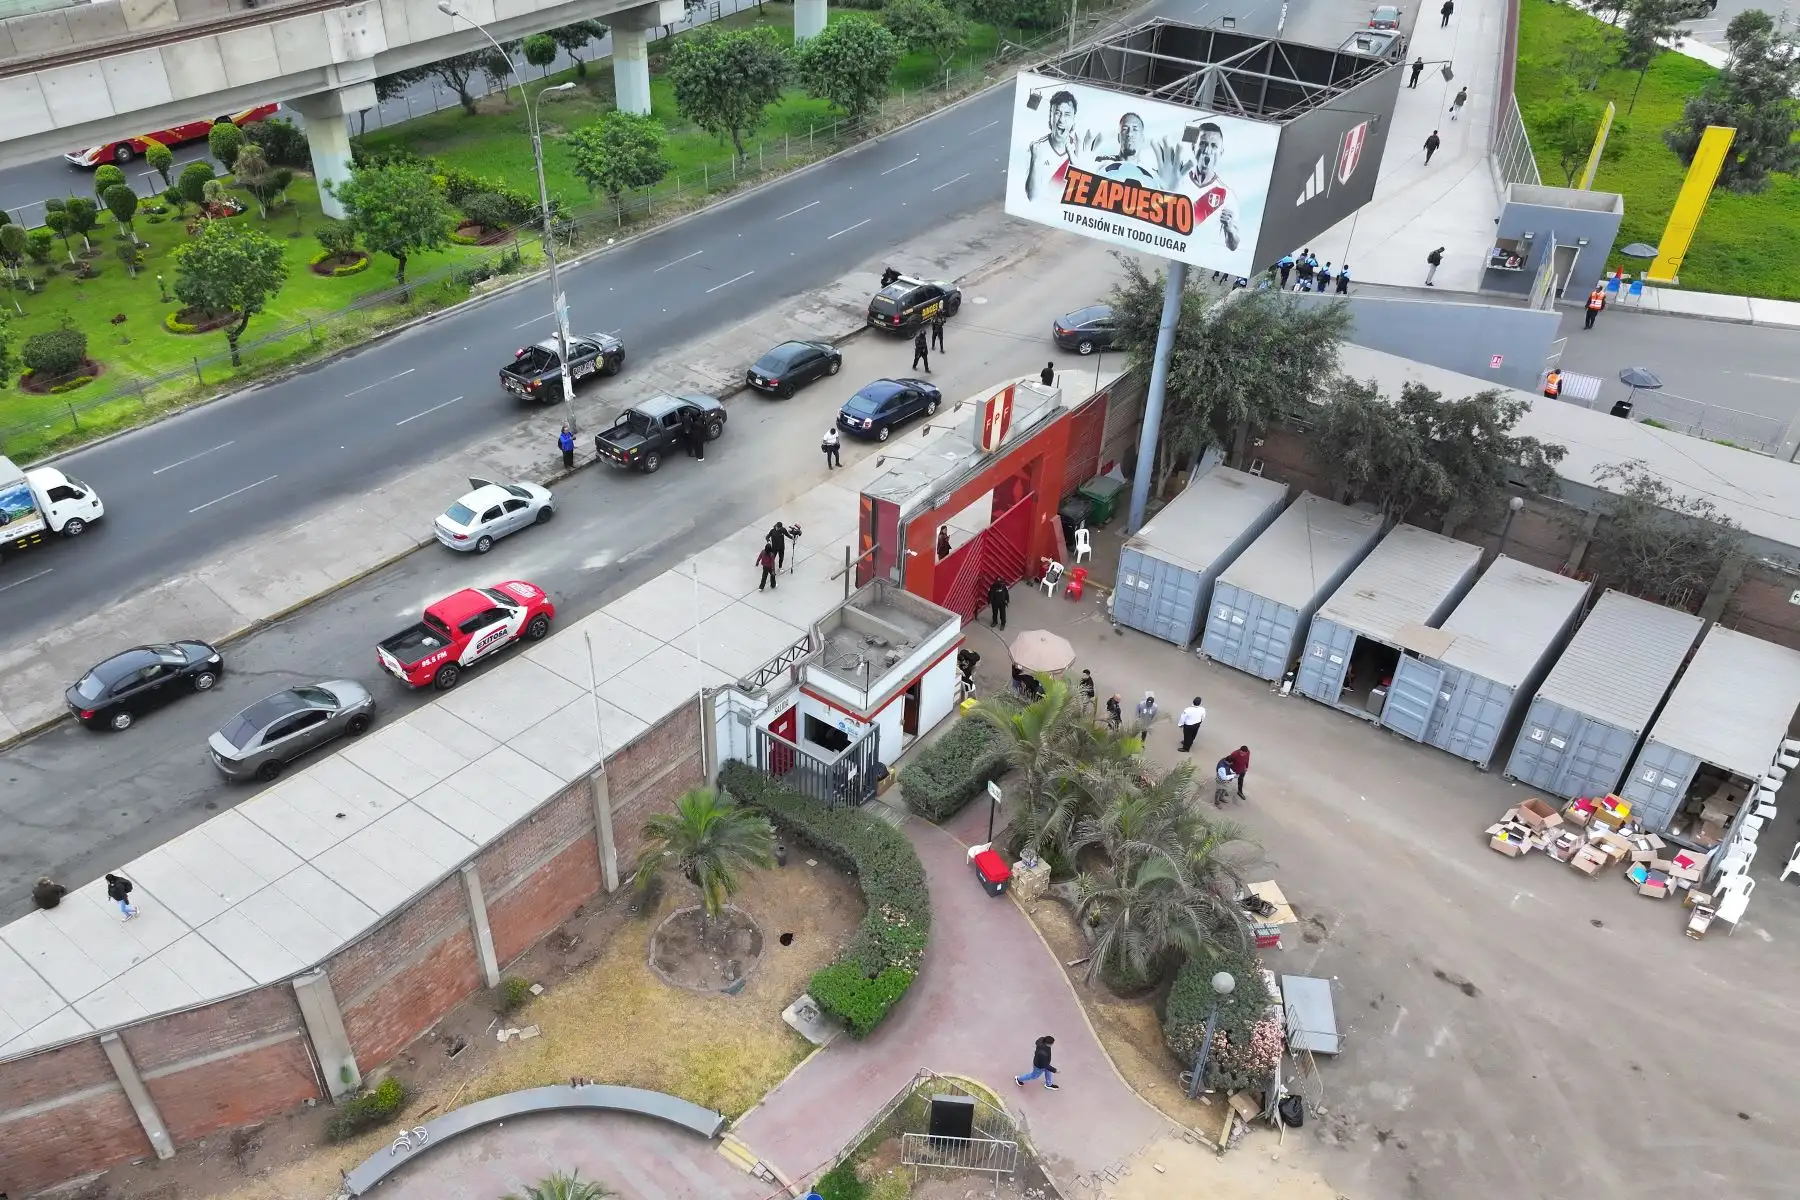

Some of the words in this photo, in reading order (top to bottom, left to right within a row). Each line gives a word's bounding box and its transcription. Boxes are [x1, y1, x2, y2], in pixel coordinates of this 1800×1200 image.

[1064, 169, 1092, 204] TE
[1091, 179, 1192, 233] APUESTO
[1063, 210, 1075, 222] TU
[1076, 214, 1110, 233] PASIÓN
[1112, 224, 1125, 237] EN
[1127, 228, 1153, 244] TODO
[1154, 235, 1187, 252] LUGAR
[986, 407, 1010, 431] FPF
[476, 628, 509, 650] EXITOSA
[437, 650, 448, 661] FM
